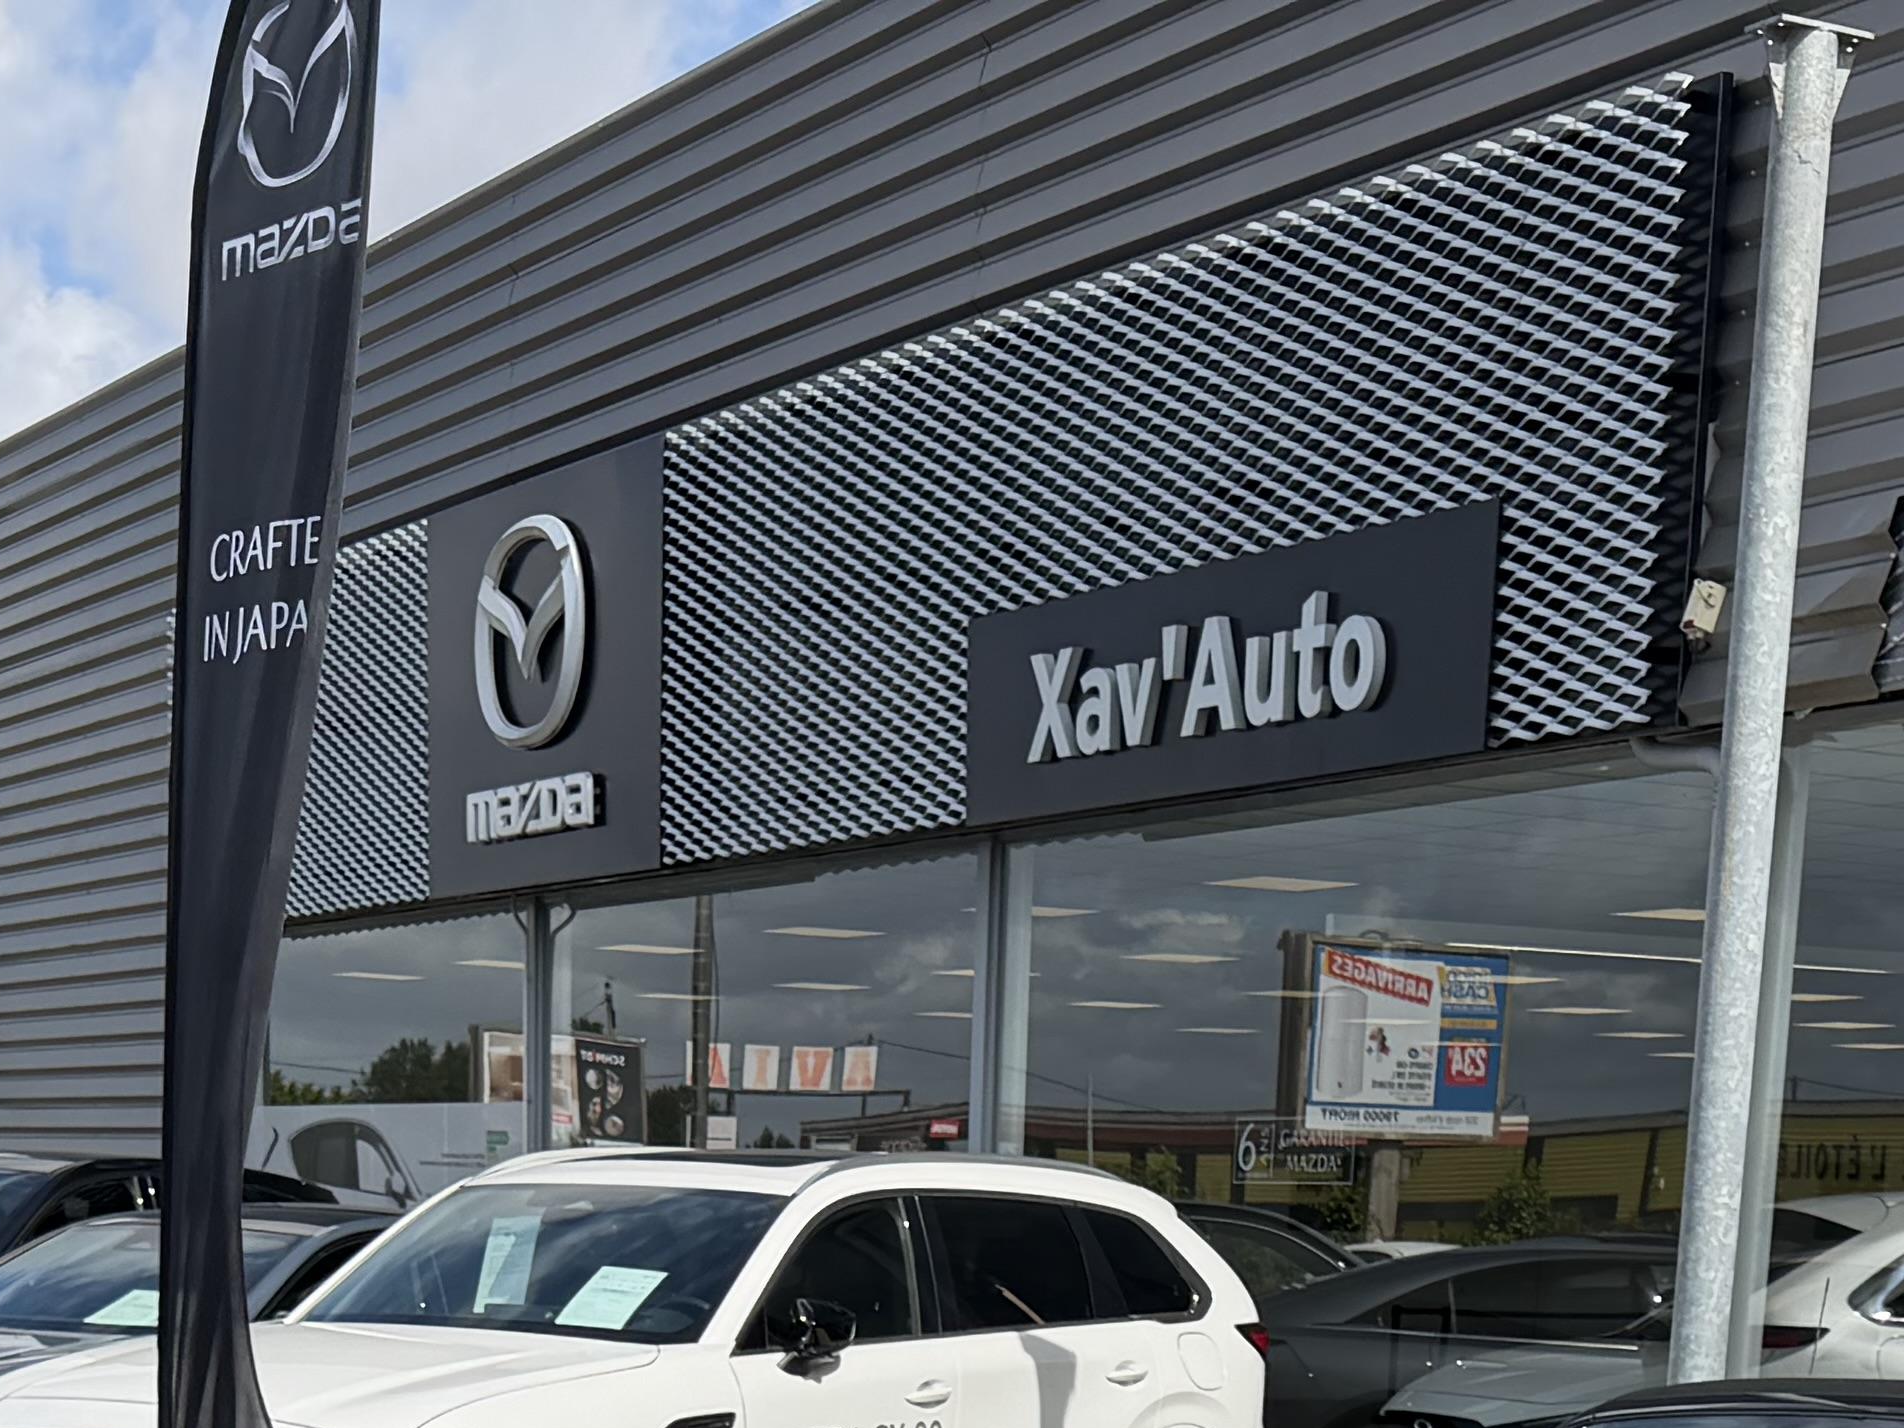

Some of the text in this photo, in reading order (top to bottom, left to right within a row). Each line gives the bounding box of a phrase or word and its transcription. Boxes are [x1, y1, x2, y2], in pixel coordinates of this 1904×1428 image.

[210, 516, 321, 582] CRAFTE
[203, 599, 308, 664] IN JAPA
[1026, 590, 1386, 764] Xav'Auto
[465, 771, 595, 843] mazda
[1238, 1122, 1256, 1172] 6
